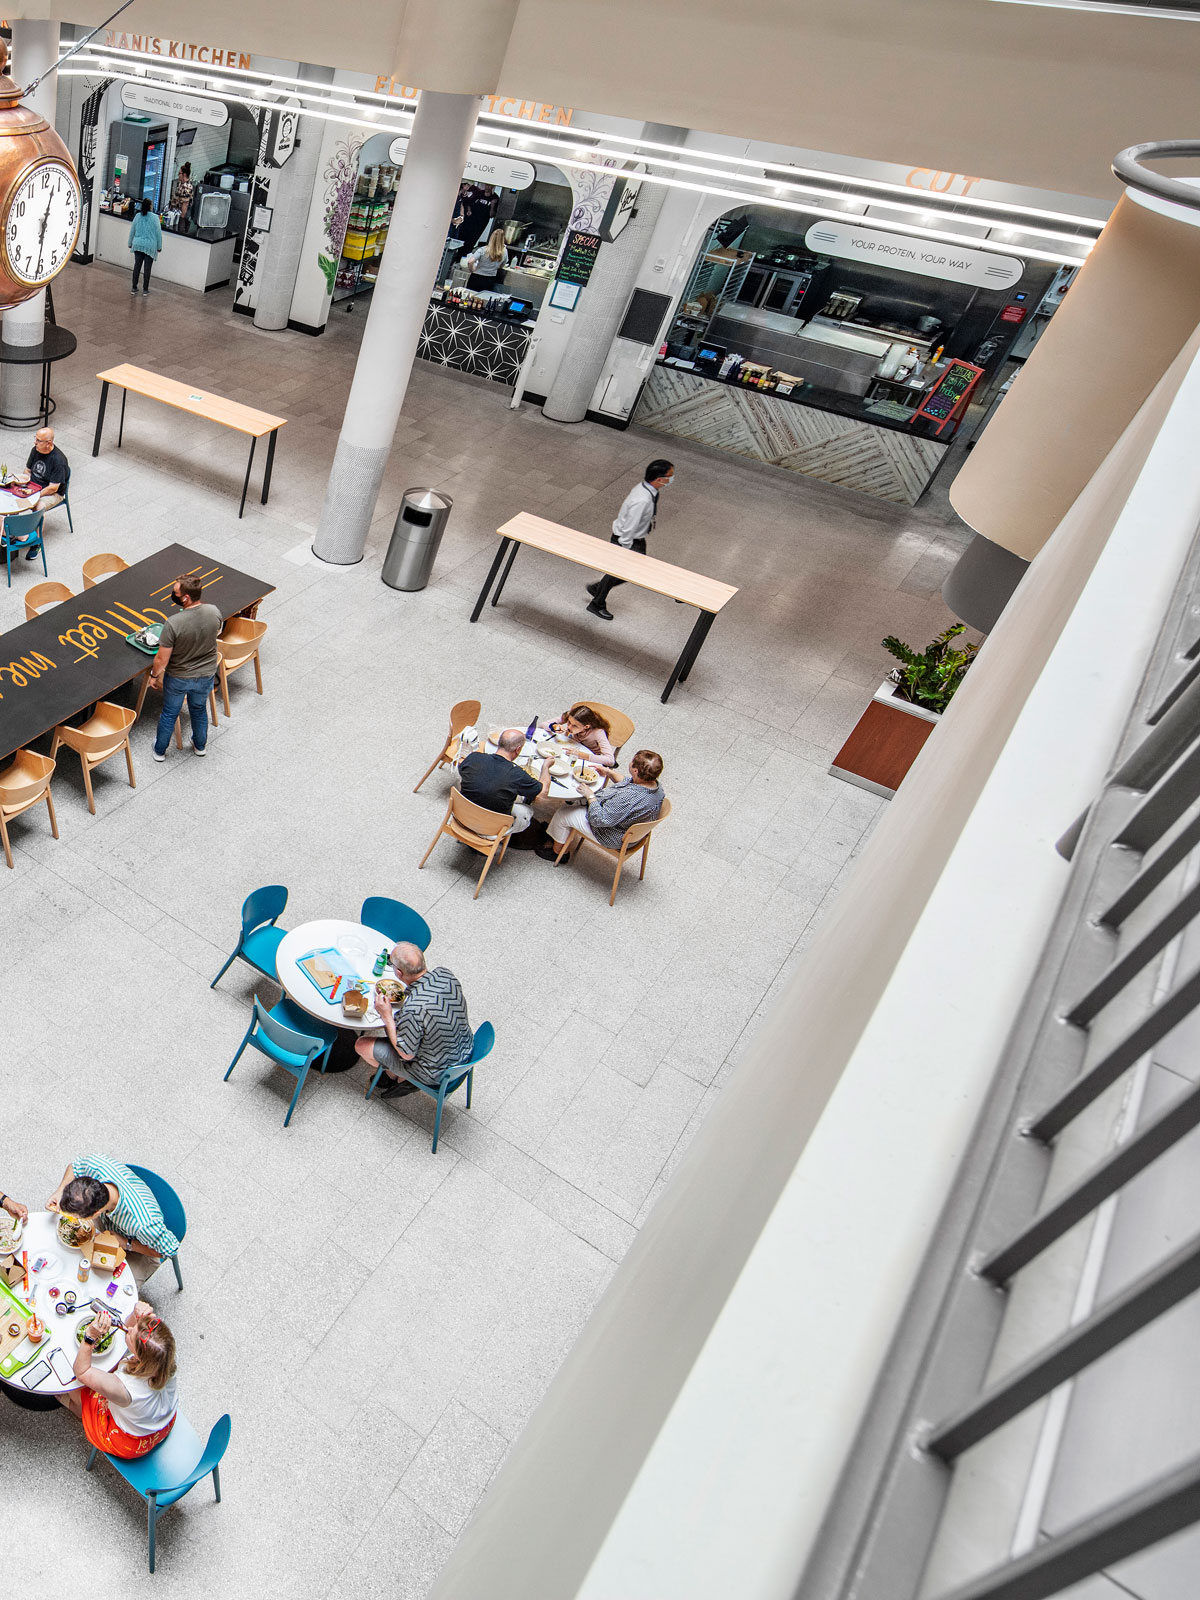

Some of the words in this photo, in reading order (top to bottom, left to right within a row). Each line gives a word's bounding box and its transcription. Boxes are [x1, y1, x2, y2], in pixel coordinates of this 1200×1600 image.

[168, 39, 251, 70] KITCHEN
[478, 164, 496, 174] LOVE
[41, 173, 50, 189] 12
[57, 177, 61, 192] 1
[905, 167, 981, 196] CUT
[27, 183, 35, 199] 11
[66, 191, 71, 206] 2
[16, 201, 25, 218] 10
[68, 211, 74, 226] 3
[10, 225, 17, 241] 9
[61, 233, 68, 248] 4
[573, 234, 599, 249] SPECIAL
[15, 245, 22, 262] 8
[51, 250, 57, 266] 5
[851, 238, 875, 250] YOUR
[877, 244, 916, 260] PROTEIN,
[920, 252, 947, 265] YOUR
[949, 259, 973, 270] WAY
[25, 256, 32, 273] 7
[37, 258, 44, 274] 6
[57, 601, 168, 663] Meet
